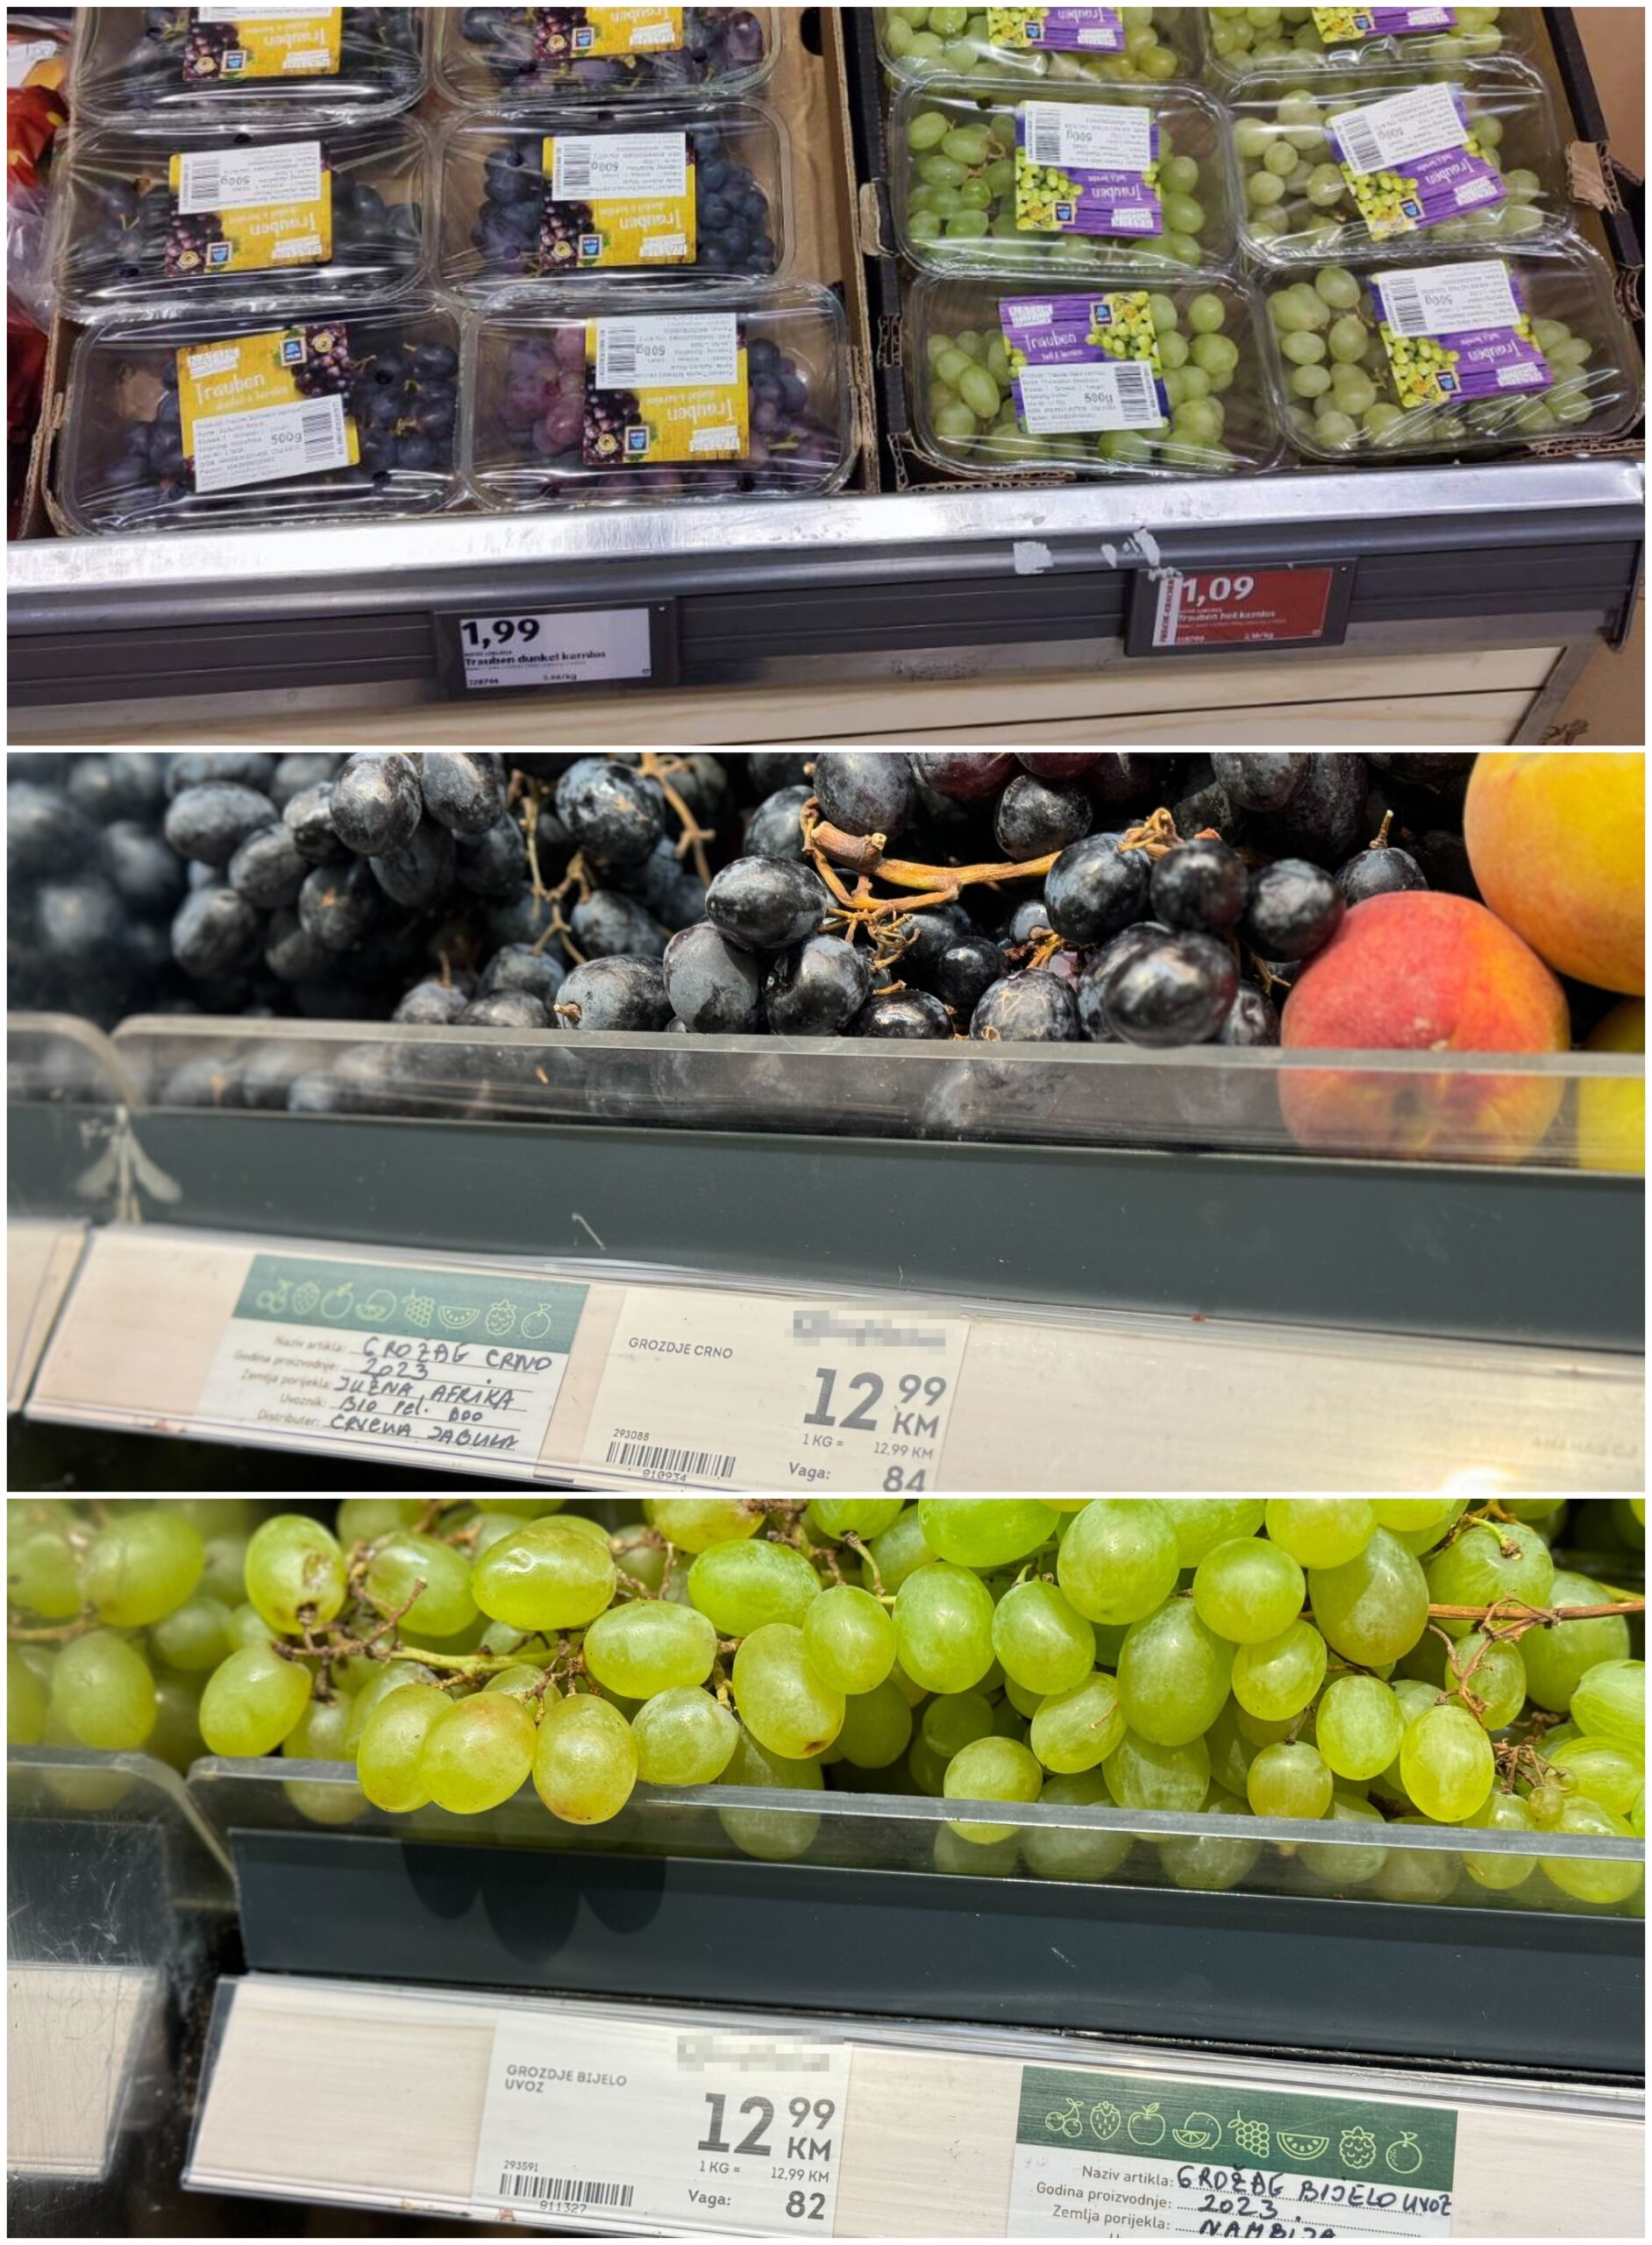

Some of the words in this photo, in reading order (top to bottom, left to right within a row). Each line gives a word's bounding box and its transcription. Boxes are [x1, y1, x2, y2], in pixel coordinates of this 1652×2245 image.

[1424, 161, 1475, 186] Trauben
[1091, 184, 1143, 202] Trauben
[619, 210, 682, 232] Trauben
[1022, 331, 1078, 353] Trauben
[1467, 339, 1522, 361] Trauben
[193, 371, 266, 405] Trauben
[667, 397, 736, 424] Trauben
[270, 431, 303, 445] 500g
[1183, 576, 1254, 607] 1,09
[462, 618, 540, 649] 1,99
[466, 655, 516, 667] Trauben
[517, 652, 559, 664] dunkel
[274, 1336, 304, 1348] Naziv
[307, 1340, 345, 1352] artikla:
[628, 1337, 691, 1356] GROZDJE
[694, 1344, 733, 1360] CRNO
[234, 1350, 270, 1363] Godina
[274, 1356, 339, 1373] proizvodnje:
[360, 1357, 429, 1381] 2023
[241, 1369, 278, 1384] Zemlja
[281, 1375, 331, 1390] porijekla:
[281, 1393, 327, 1408] Uvoznik:
[431, 1384, 516, 1410] AFRIKA
[803, 1366, 885, 1432] 12
[898, 1373, 947, 1407] 99
[257, 1409, 321, 1428] Distributer:
[892, 1411, 940, 1439] KM
[613, 1428, 650, 1441] 293088
[812, 1434, 833, 1448] KG
[911, 1446, 934, 1460] KM
[788, 1462, 831, 1482] Vaga:
[883, 1465, 927, 1492] 84
[505, 2078, 545, 2093] UVOZ
[507, 2064, 573, 2083] GROZDJE
[577, 2070, 627, 2086] BIJELO
[697, 2092, 775, 2156] 12
[788, 2097, 836, 2130] 99
[787, 2136, 832, 2162] KM
[503, 2160, 538, 2173] 293591
[709, 2162, 730, 2175] KG
[808, 2170, 830, 2184] KM
[1082, 2165, 1120, 2181] Naziv
[1123, 2170, 1174, 2187] artikla:
[1036, 2181, 1084, 2199] Godina
[1088, 2190, 1171, 2211] proizvodnje:
[1298, 2177, 1397, 2208] BIJELO
[539, 2199, 587, 2214] 811327
[687, 2189, 731, 2208] Vaga:
[786, 2191, 826, 2220] 82
[1052, 2205, 1100, 2224] Zemlja
[1104, 2213, 1170, 2229] porijekla:
